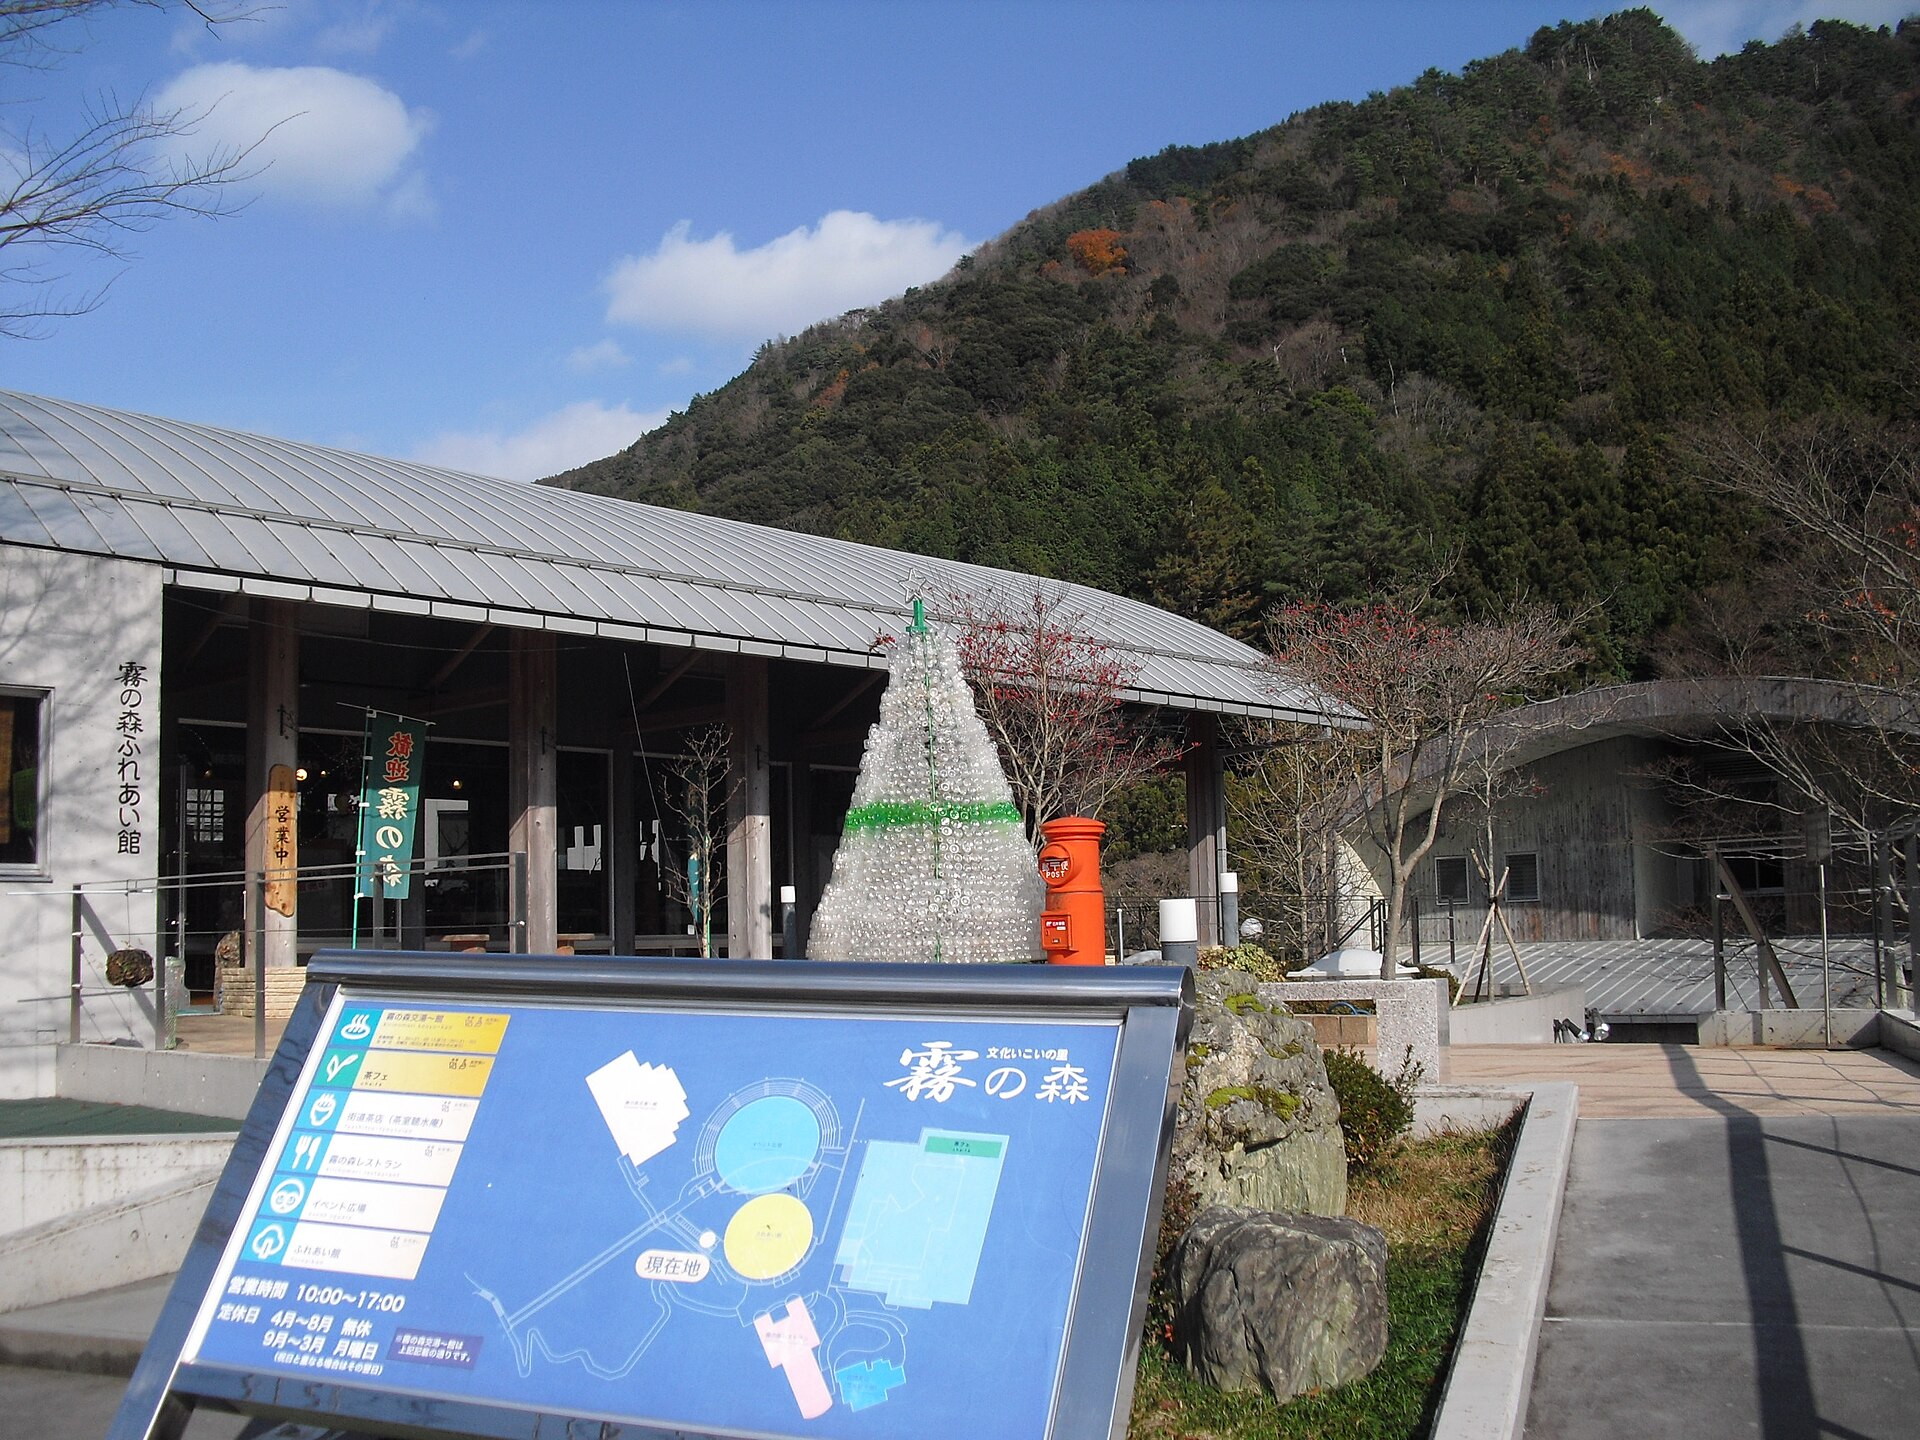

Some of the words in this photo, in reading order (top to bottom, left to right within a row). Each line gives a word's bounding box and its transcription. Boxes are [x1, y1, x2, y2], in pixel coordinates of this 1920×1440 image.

[114, 662, 148, 854] 霧の森ふれあい館
[275, 806, 290, 865] 営業中
[1045, 870, 1065, 879] POST
[987, 1046, 1069, 1061] 文化いこいの里
[364, 1071, 388, 1082] 茶フェ
[883, 1041, 1090, 1104] 霧の森
[328, 1155, 403, 1170] 霧の森レストラン
[312, 1200, 367, 1213] イベント広場
[294, 1244, 341, 1259] ふれあい館
[643, 1255, 701, 1277] 現在地
[227, 1276, 289, 1300] 営業時間
[297, 1284, 406, 1313] 10:00～17:00
[217, 1302, 262, 1325] 定休日
[270, 1310, 334, 1334] 4月～8月
[341, 1317, 373, 1338] 無休
[262, 1329, 326, 1354] 9月～3月
[333, 1337, 379, 1361] 月曜日
